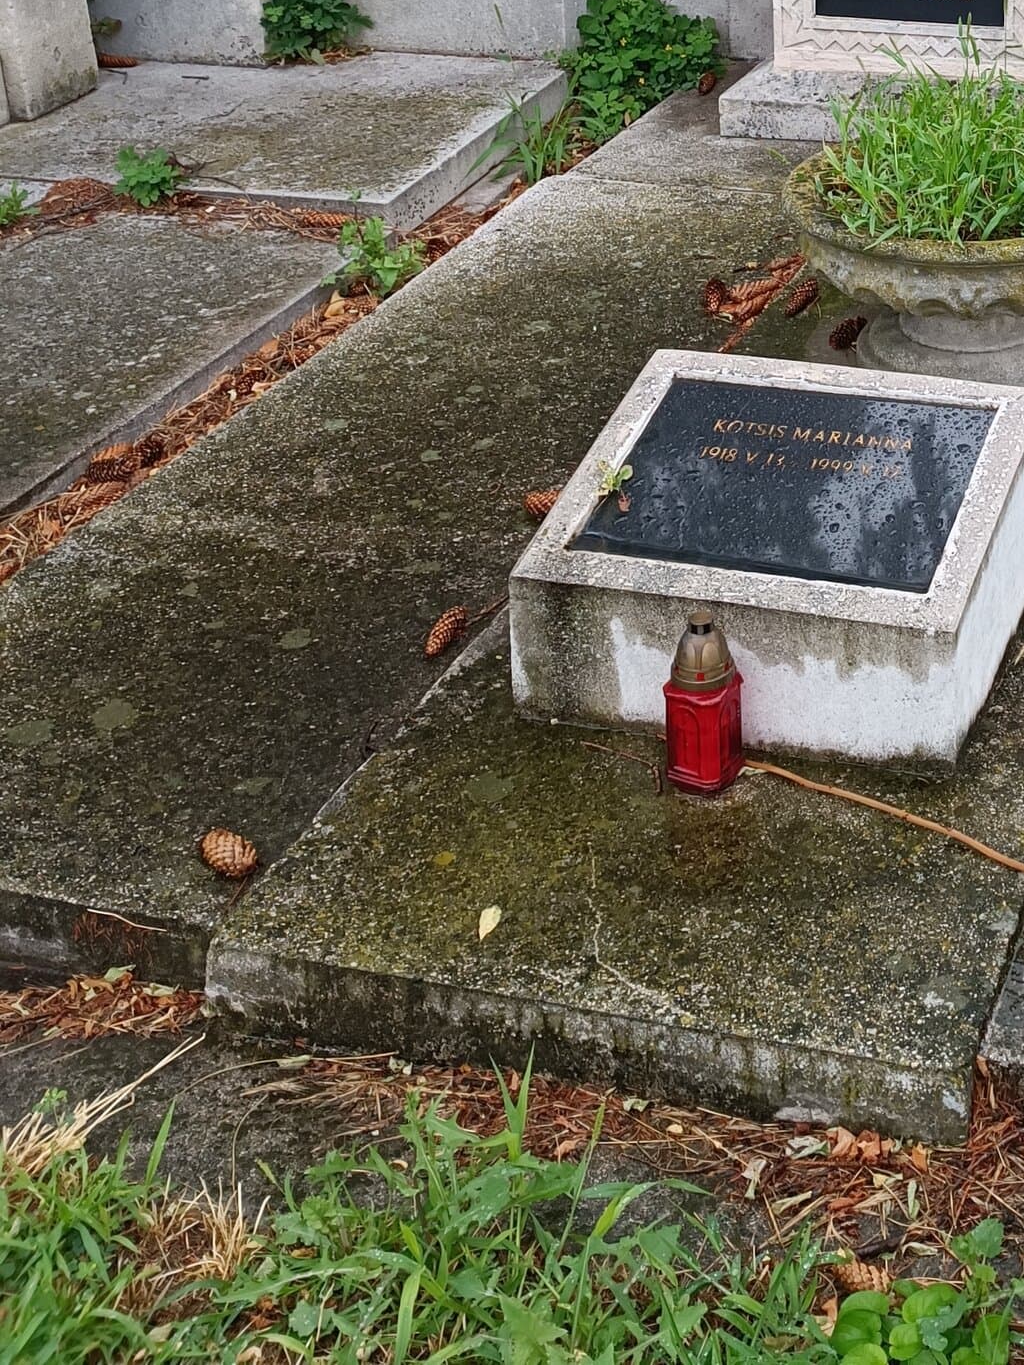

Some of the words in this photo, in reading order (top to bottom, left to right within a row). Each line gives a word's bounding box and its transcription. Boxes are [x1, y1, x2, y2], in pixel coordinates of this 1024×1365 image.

[713, 418, 788, 439] KOTSIS
[791, 426, 914, 452] MARIANNA
[699, 445, 738, 463] 1918
